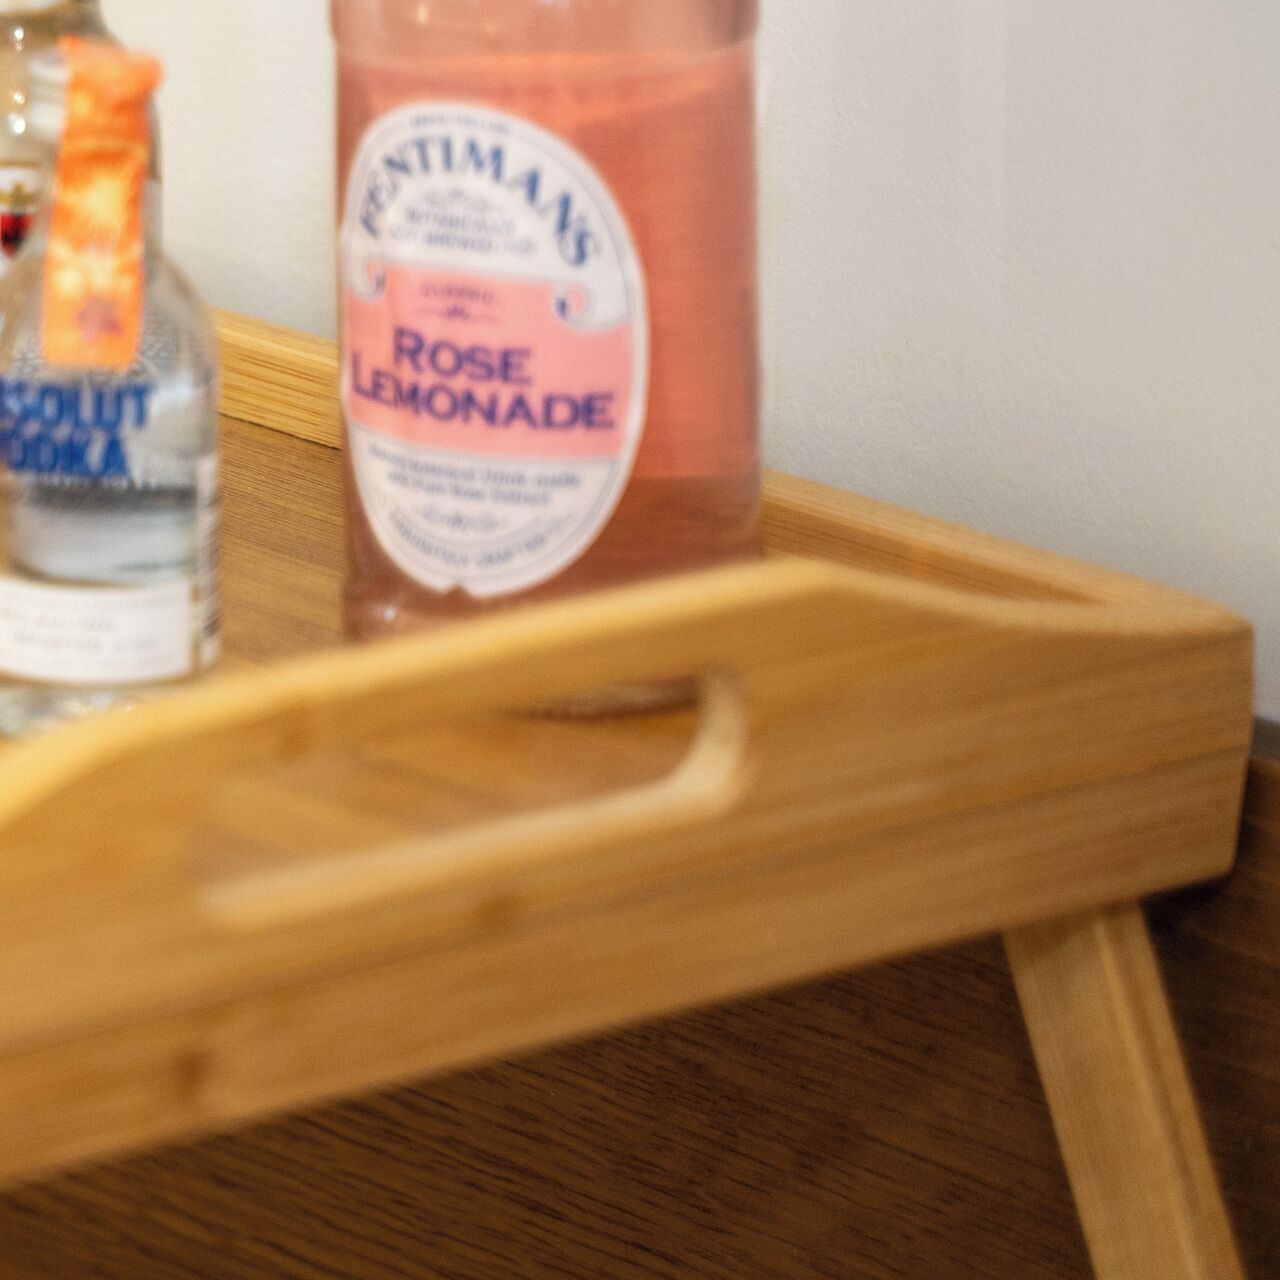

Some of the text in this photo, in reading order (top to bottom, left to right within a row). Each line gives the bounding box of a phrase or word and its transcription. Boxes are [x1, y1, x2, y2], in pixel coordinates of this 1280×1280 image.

[360, 136, 603, 268] FENTIMANS
[351, 351, 616, 431] LEMONADE
[393, 325, 532, 386] ROSE
